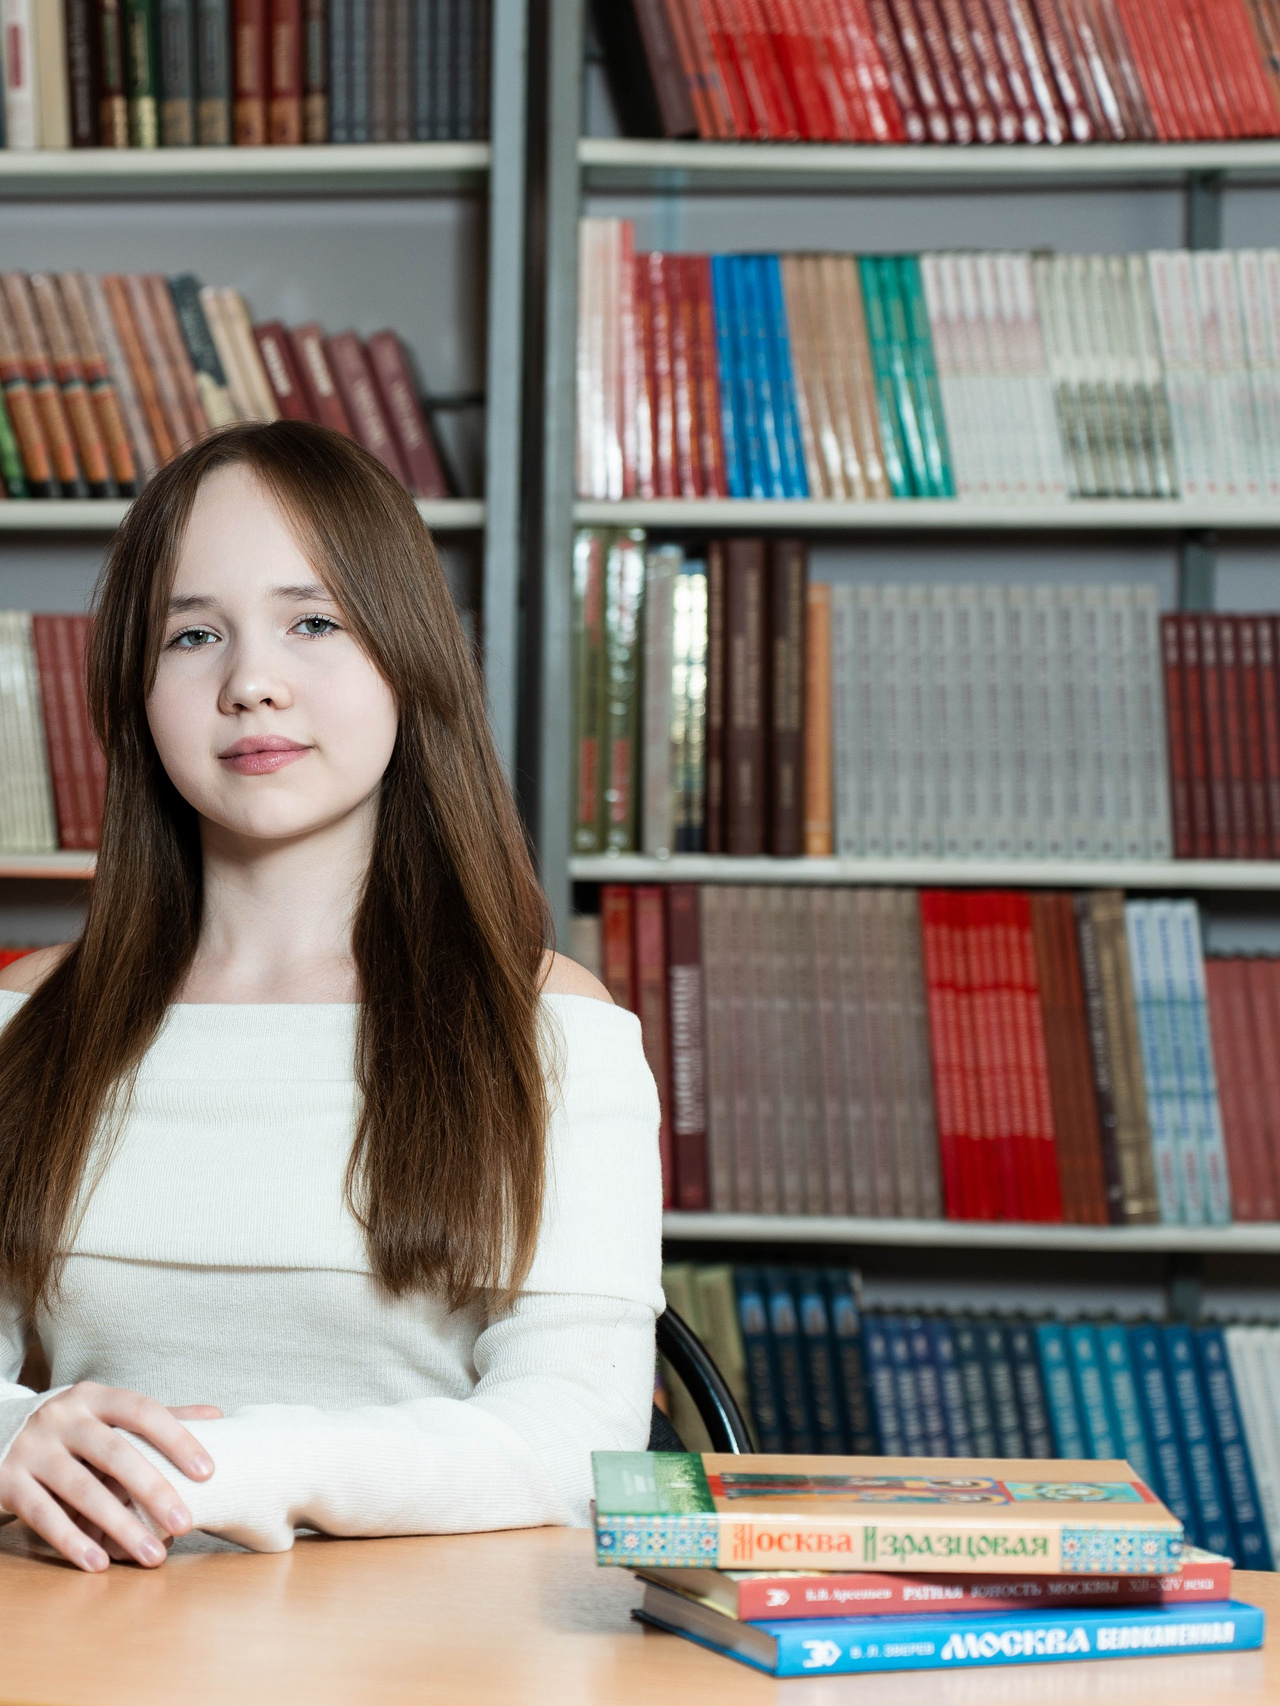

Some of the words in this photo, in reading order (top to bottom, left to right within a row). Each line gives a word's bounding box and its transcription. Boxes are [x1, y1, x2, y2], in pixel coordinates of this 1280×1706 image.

[732, 1523, 854, 1561] Москва
[970, 1581, 1042, 1598] ЮНОСТЬ
[1047, 1580, 1120, 1596] МОСКВЫ
[940, 1627, 1091, 1660] МОСКВА
[1096, 1621, 1235, 1650] БЕЛОКАМЕННАЯ
